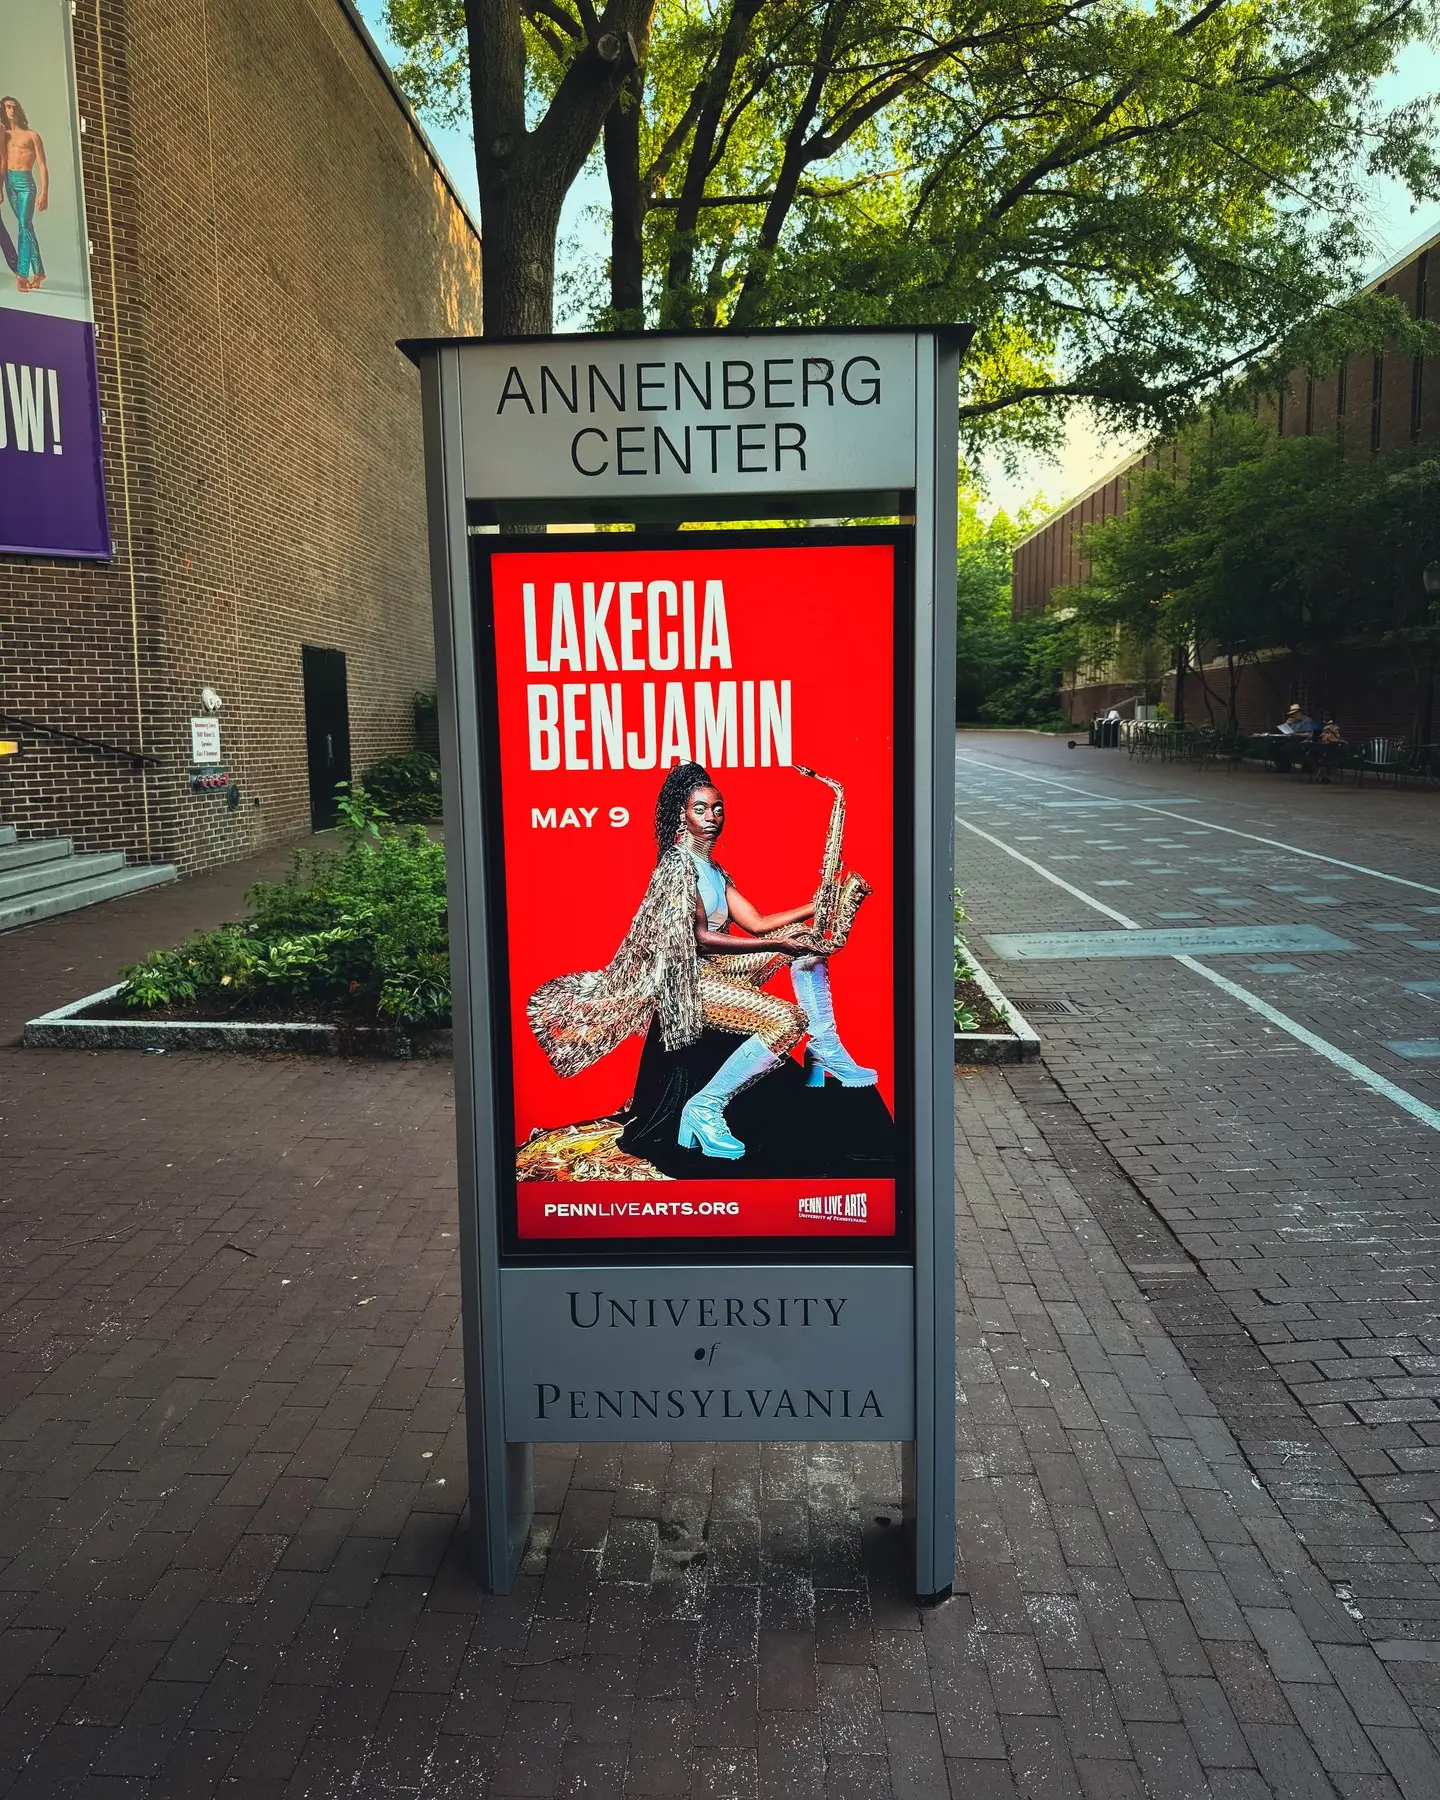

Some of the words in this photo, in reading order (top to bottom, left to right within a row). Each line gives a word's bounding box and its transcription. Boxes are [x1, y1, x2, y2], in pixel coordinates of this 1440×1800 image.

[496, 355, 882, 415] ANNENBERG
[0, 362, 63, 455] W!
[570, 422, 807, 477] CENTER
[522, 579, 733, 673] LAKECIA
[526, 679, 793, 771] BENJAMIN
[531, 806, 599, 829] MAY
[608, 806, 630, 829] 9
[544, 1201, 740, 1217] PENNLIVEARTS.ORG
[798, 1196, 822, 1213] PENN
[824, 1194, 843, 1216] LIVE
[844, 1192, 867, 1218] ARTS
[565, 1291, 849, 1329] UNIVERSITY
[533, 1383, 885, 1420] PENNSYLVANIA
